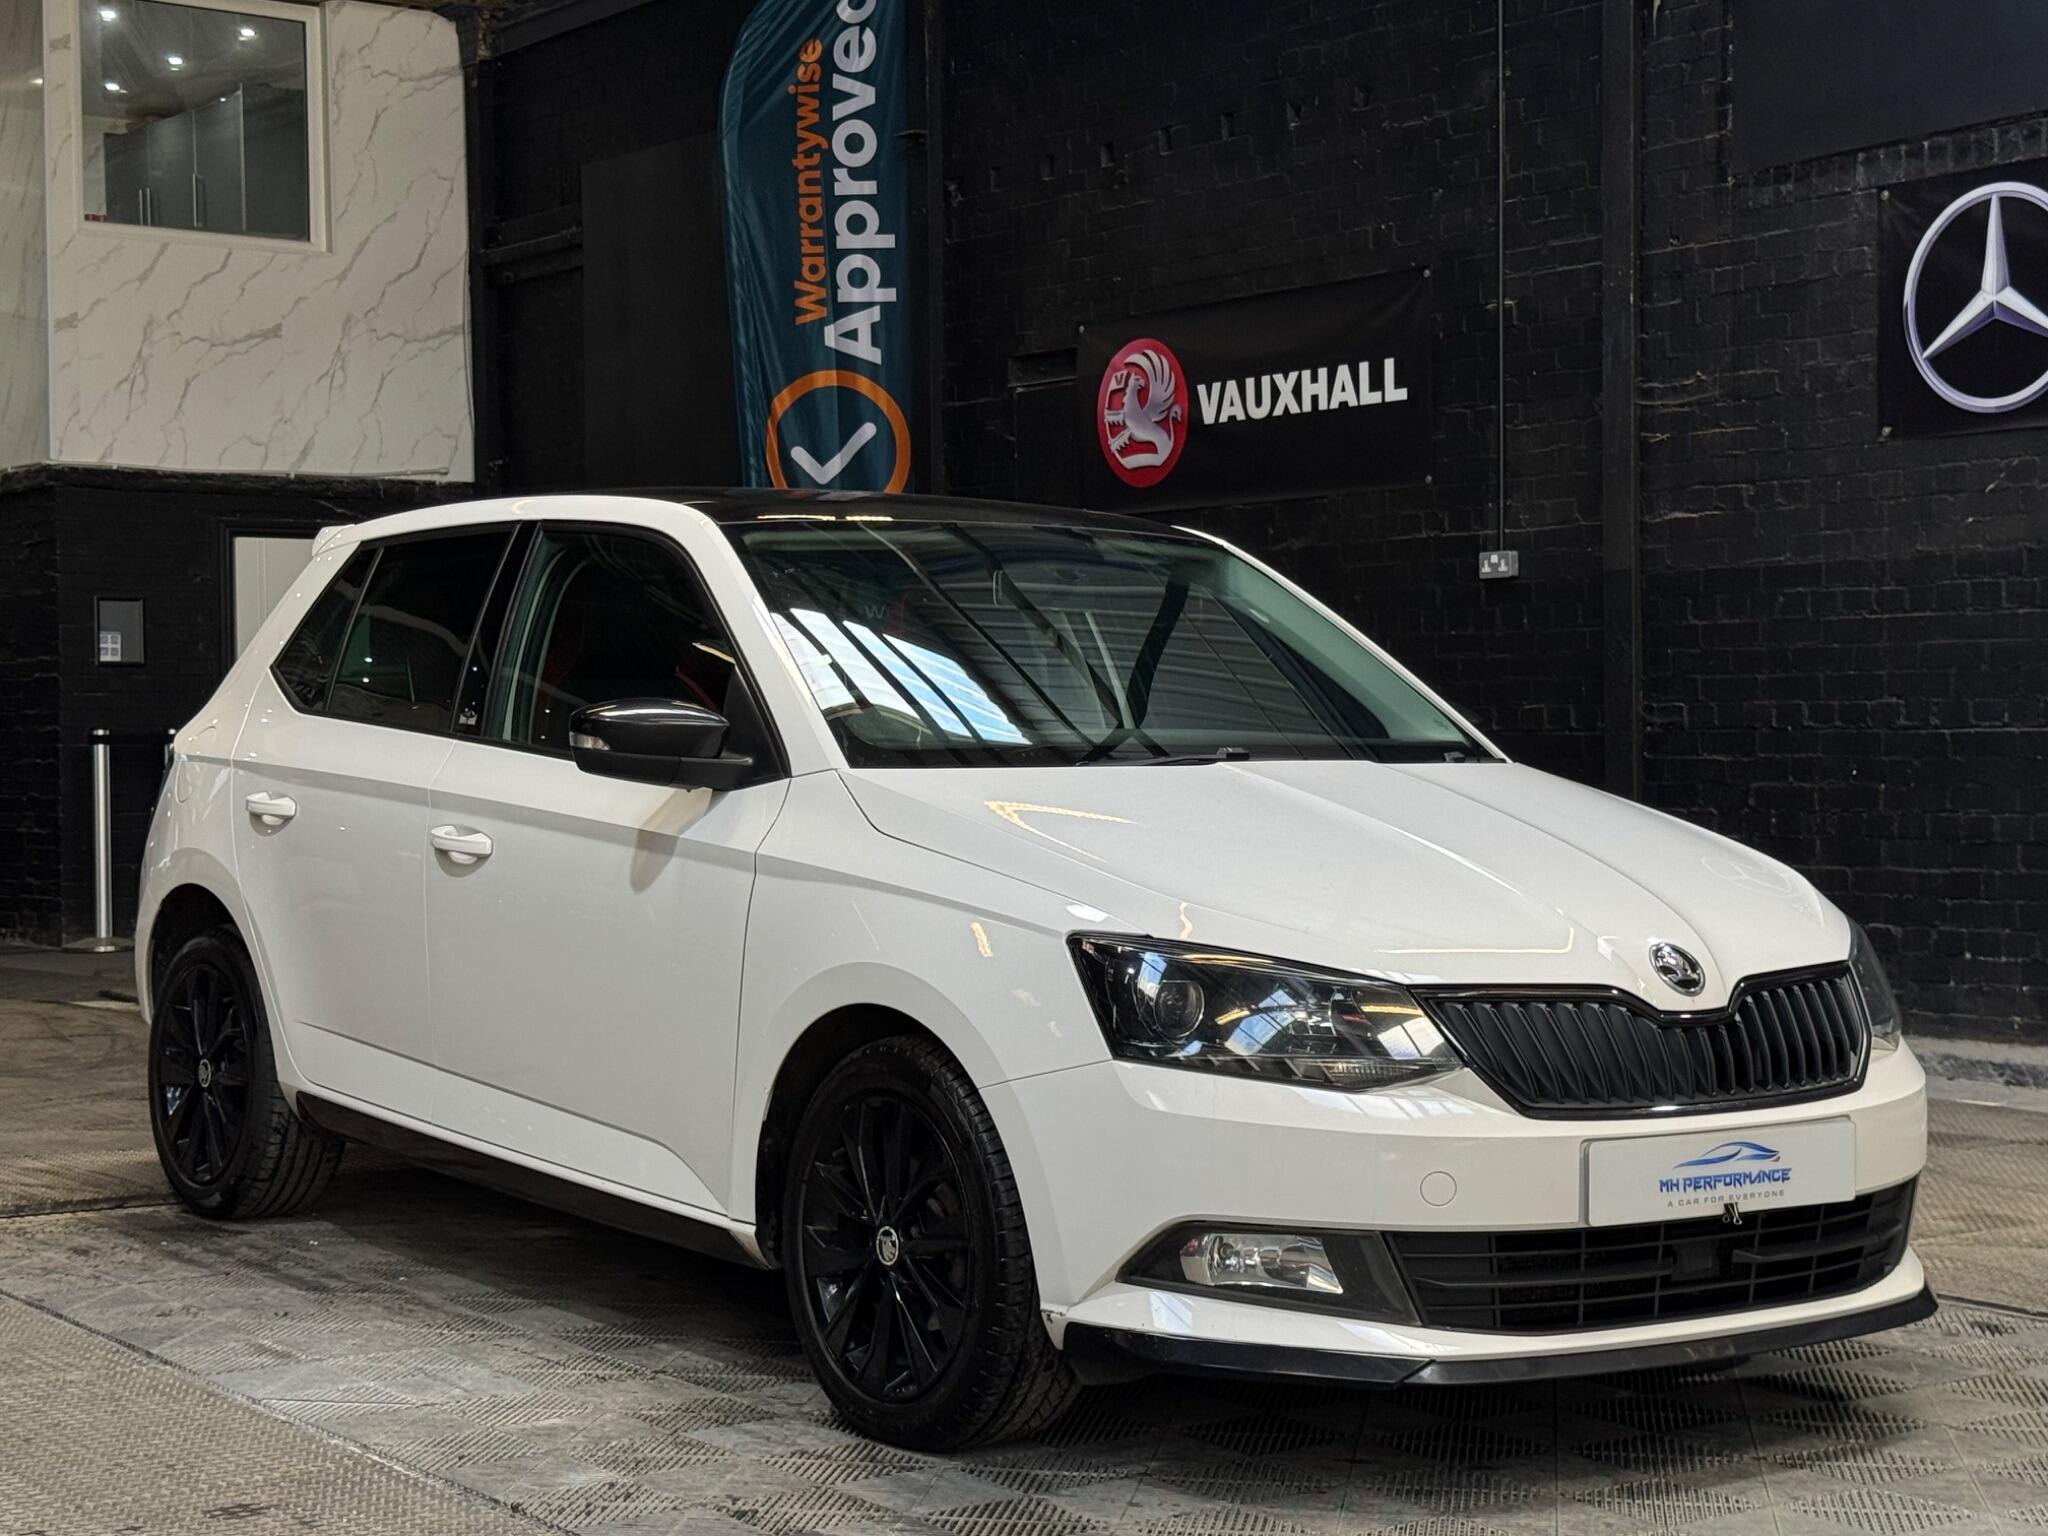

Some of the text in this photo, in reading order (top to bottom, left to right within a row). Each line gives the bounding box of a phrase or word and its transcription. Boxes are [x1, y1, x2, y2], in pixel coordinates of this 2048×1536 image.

[788, 38, 829, 325] Warrantywise
[1197, 357, 1408, 425] VAUXHALL
[1659, 1168, 1792, 1193] MH PERFORMANCE
[1678, 1197, 1700, 1207] CAR
[1704, 1195, 1725, 1204] FOR
[1728, 1189, 1785, 1202] EVERYONE
